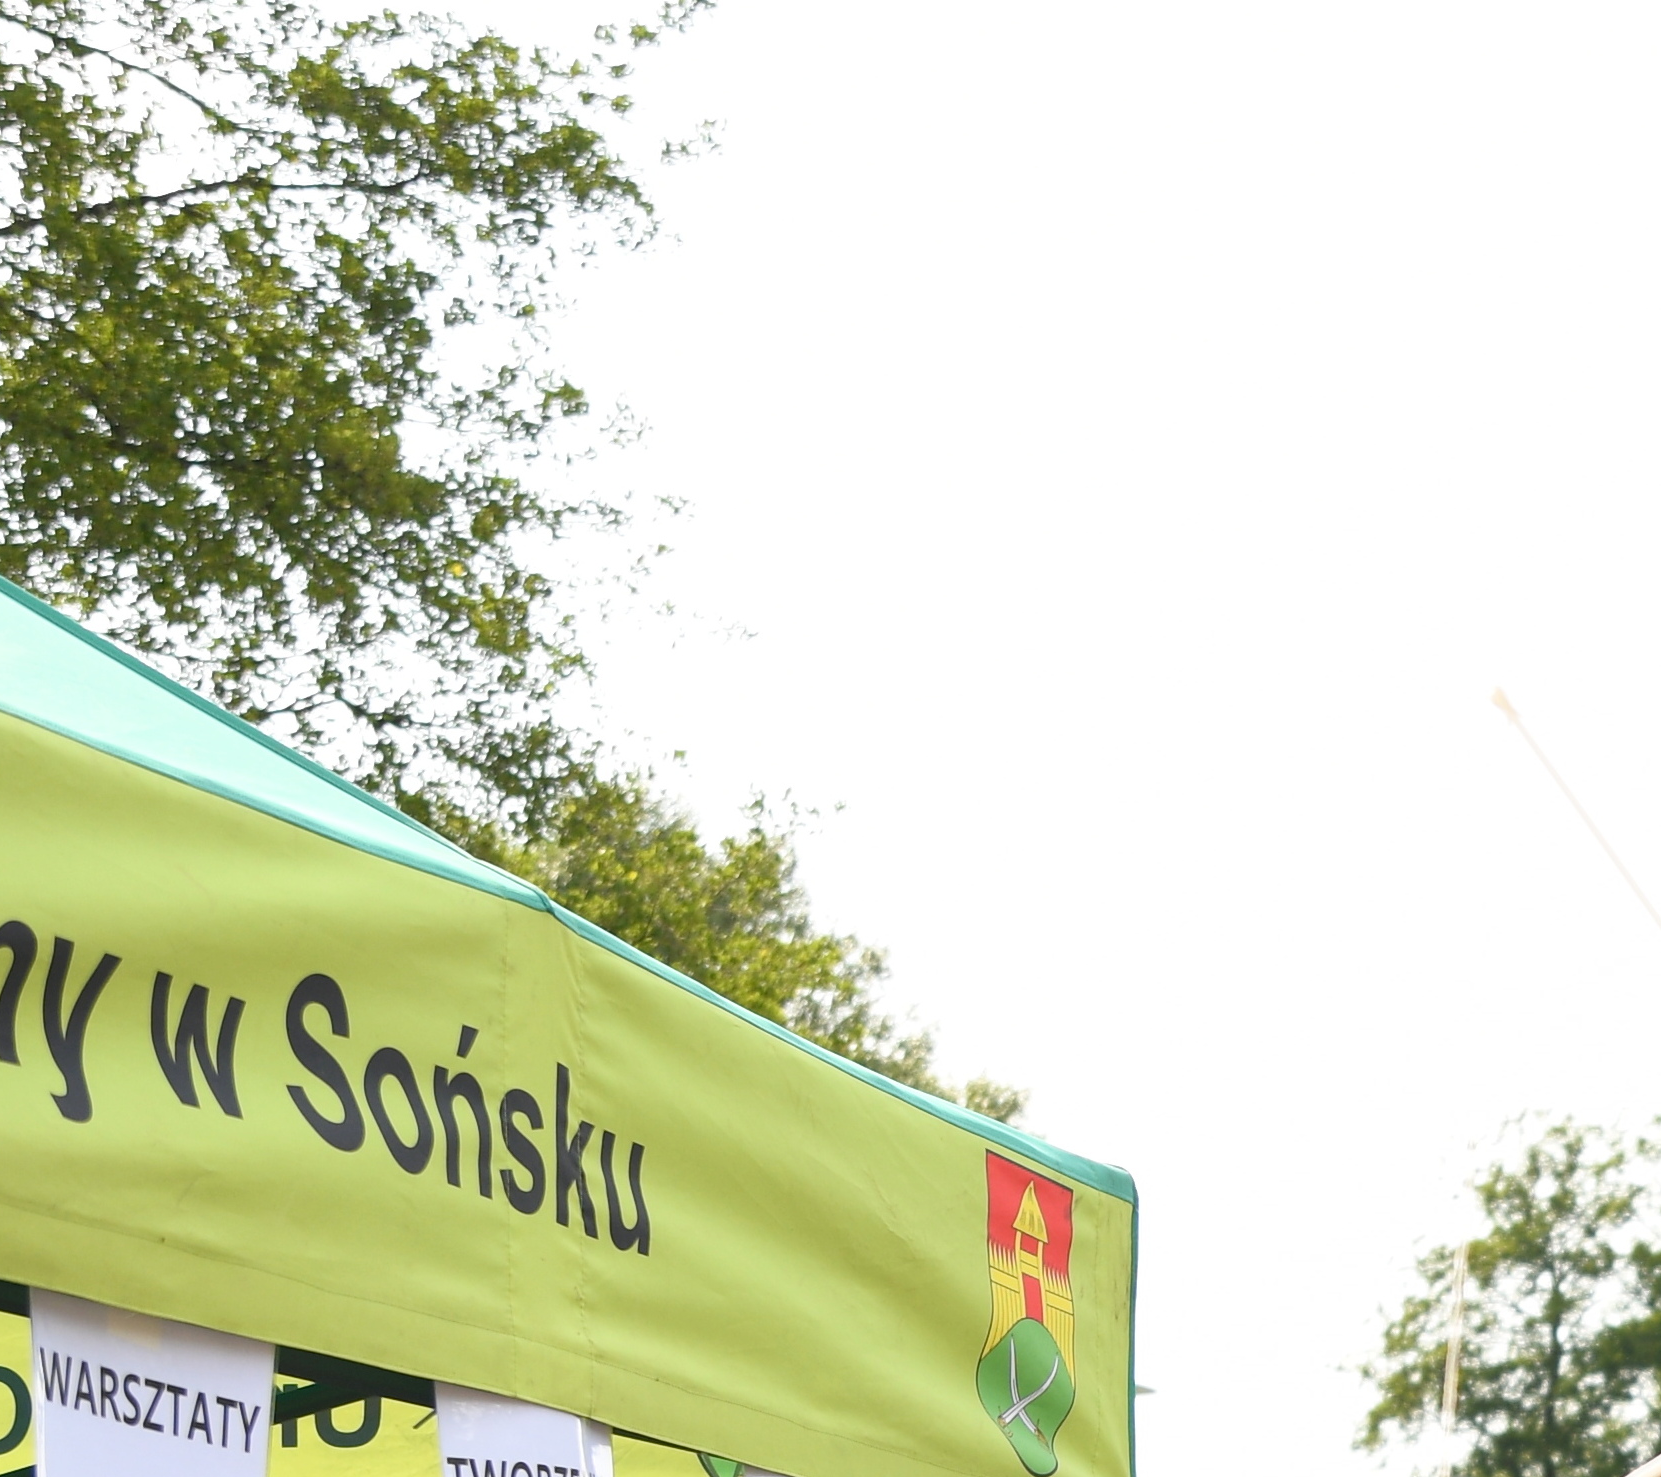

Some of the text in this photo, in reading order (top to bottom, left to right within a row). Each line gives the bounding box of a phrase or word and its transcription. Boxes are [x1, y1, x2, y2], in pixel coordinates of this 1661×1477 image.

[150, 970, 245, 1120] w
[284, 972, 652, 1257] Sońsku
[39, 1346, 261, 1454] WARSZTATY
